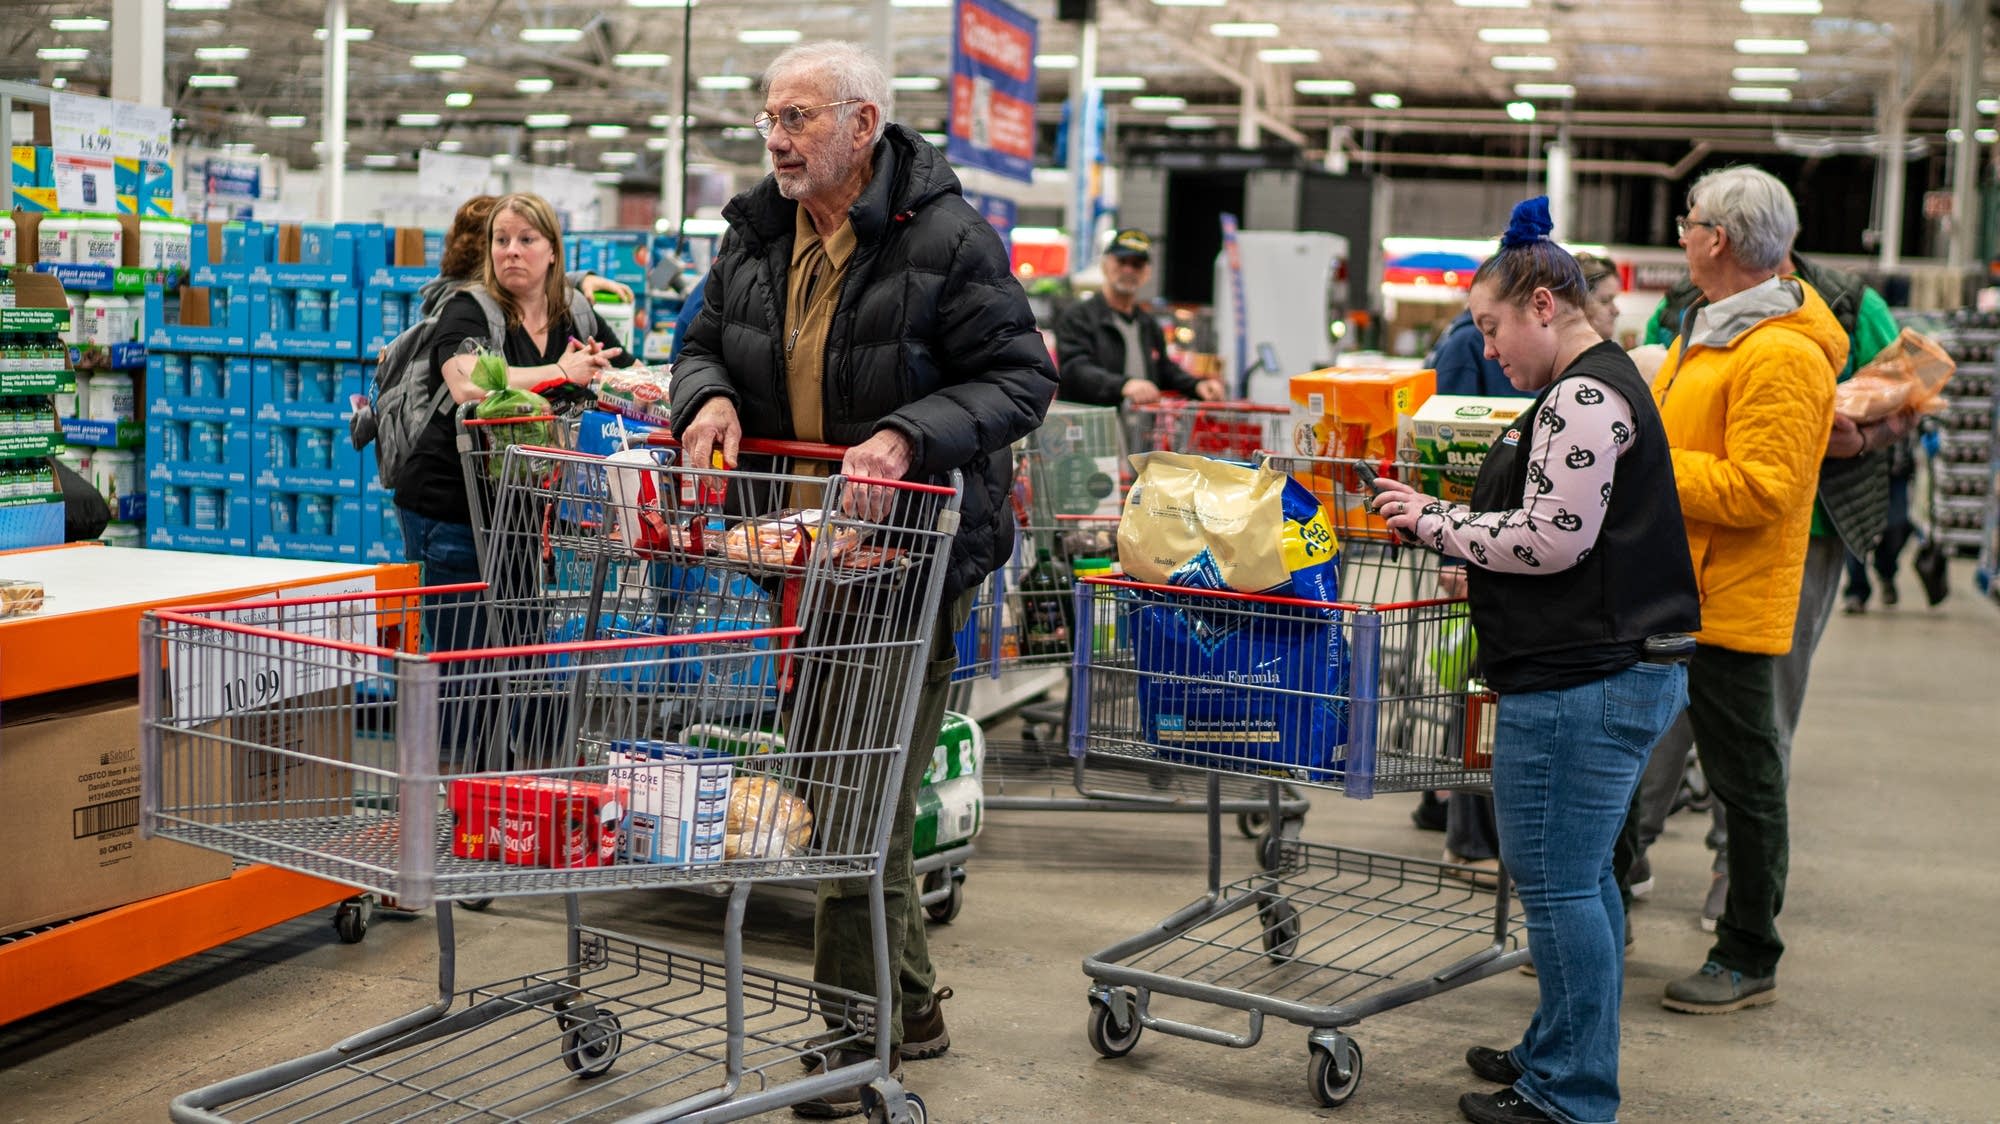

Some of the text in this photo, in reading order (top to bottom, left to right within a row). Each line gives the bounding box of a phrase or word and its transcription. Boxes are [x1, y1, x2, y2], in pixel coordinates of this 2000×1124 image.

[81, 133, 112, 151] 14.99
[117, 272, 140, 285] Orgain
[602, 395, 629, 407] ITALIAN
[622, 408, 663, 425] TWIN PACK
[653, 406, 671, 419] ITALI
[62, 424, 81, 435] plant
[82, 425, 108, 437] protein
[1447, 451, 1488, 464] BLAC
[1154, 556, 1177, 567] Healthy
[1314, 573, 1330, 616] Frmula
[1329, 649, 1339, 668] Life
[1227, 669, 1281, 684] Formula
[223, 669, 280, 713] 10.99
[1159, 718, 1183, 727] ADULT
[78, 771, 107, 783] COSTCO
[107, 769, 121, 777] Item
[88, 775, 142, 792] Danish Clamshel
[611, 769, 658, 785] ALBACORE
[498, 817, 533, 832] LARGE
[108, 841, 133, 853] CNT/CS
[461, 832, 484, 854] 6 PACK
